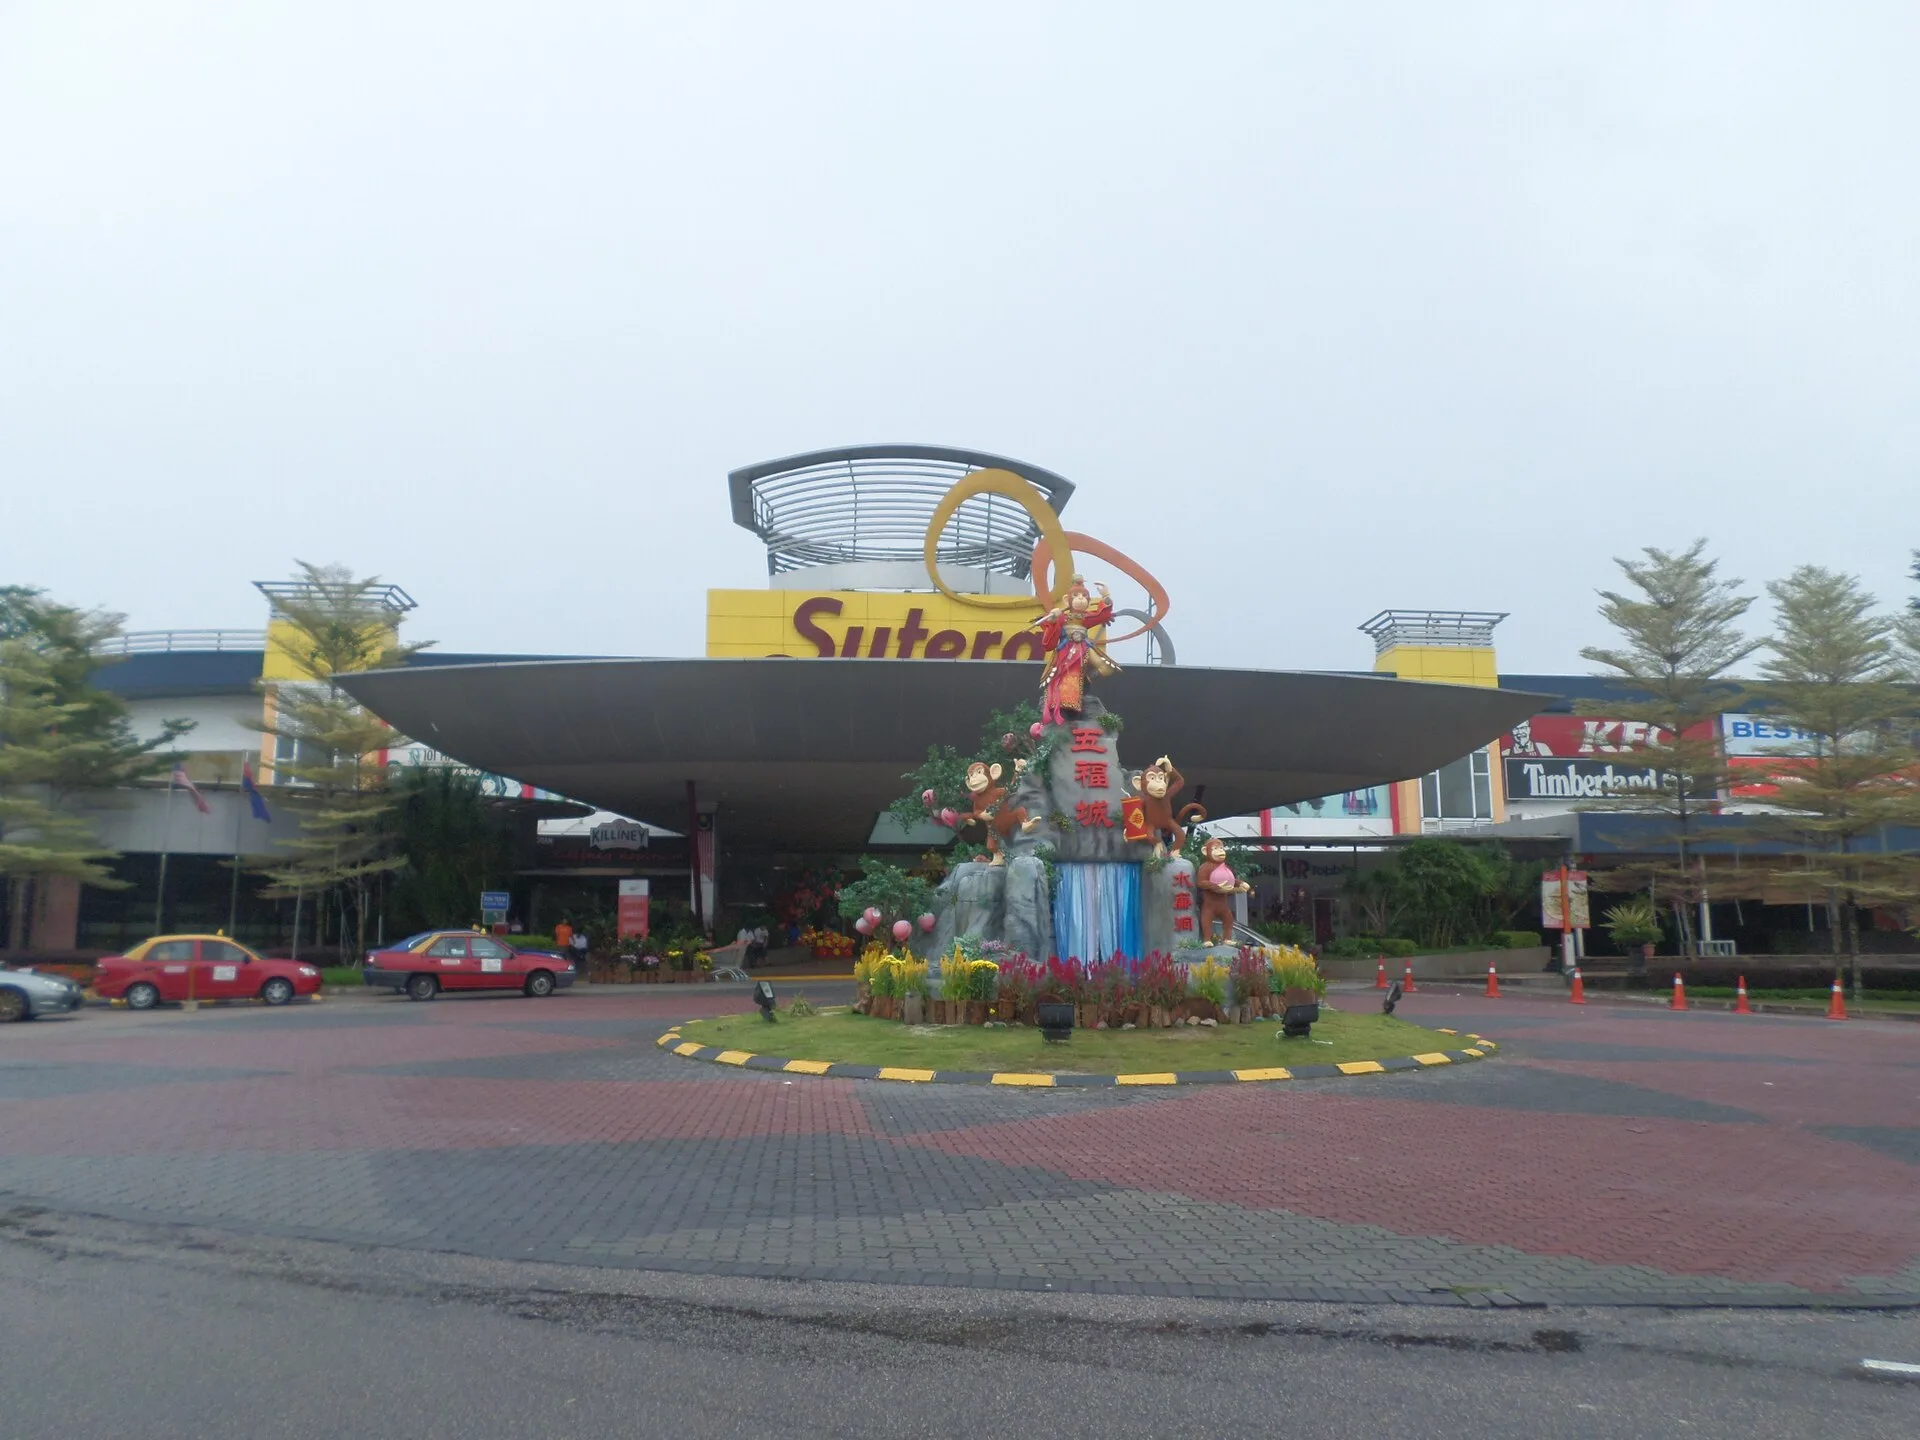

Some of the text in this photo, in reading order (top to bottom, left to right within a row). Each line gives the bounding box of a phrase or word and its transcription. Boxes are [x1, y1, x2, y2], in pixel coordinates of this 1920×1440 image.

[1578, 721, 1677, 753] KFC
[1070, 727, 1114, 829] 五福城
[1523, 761, 1658, 797] Timberland
[591, 828, 646, 845] KILLINEY
